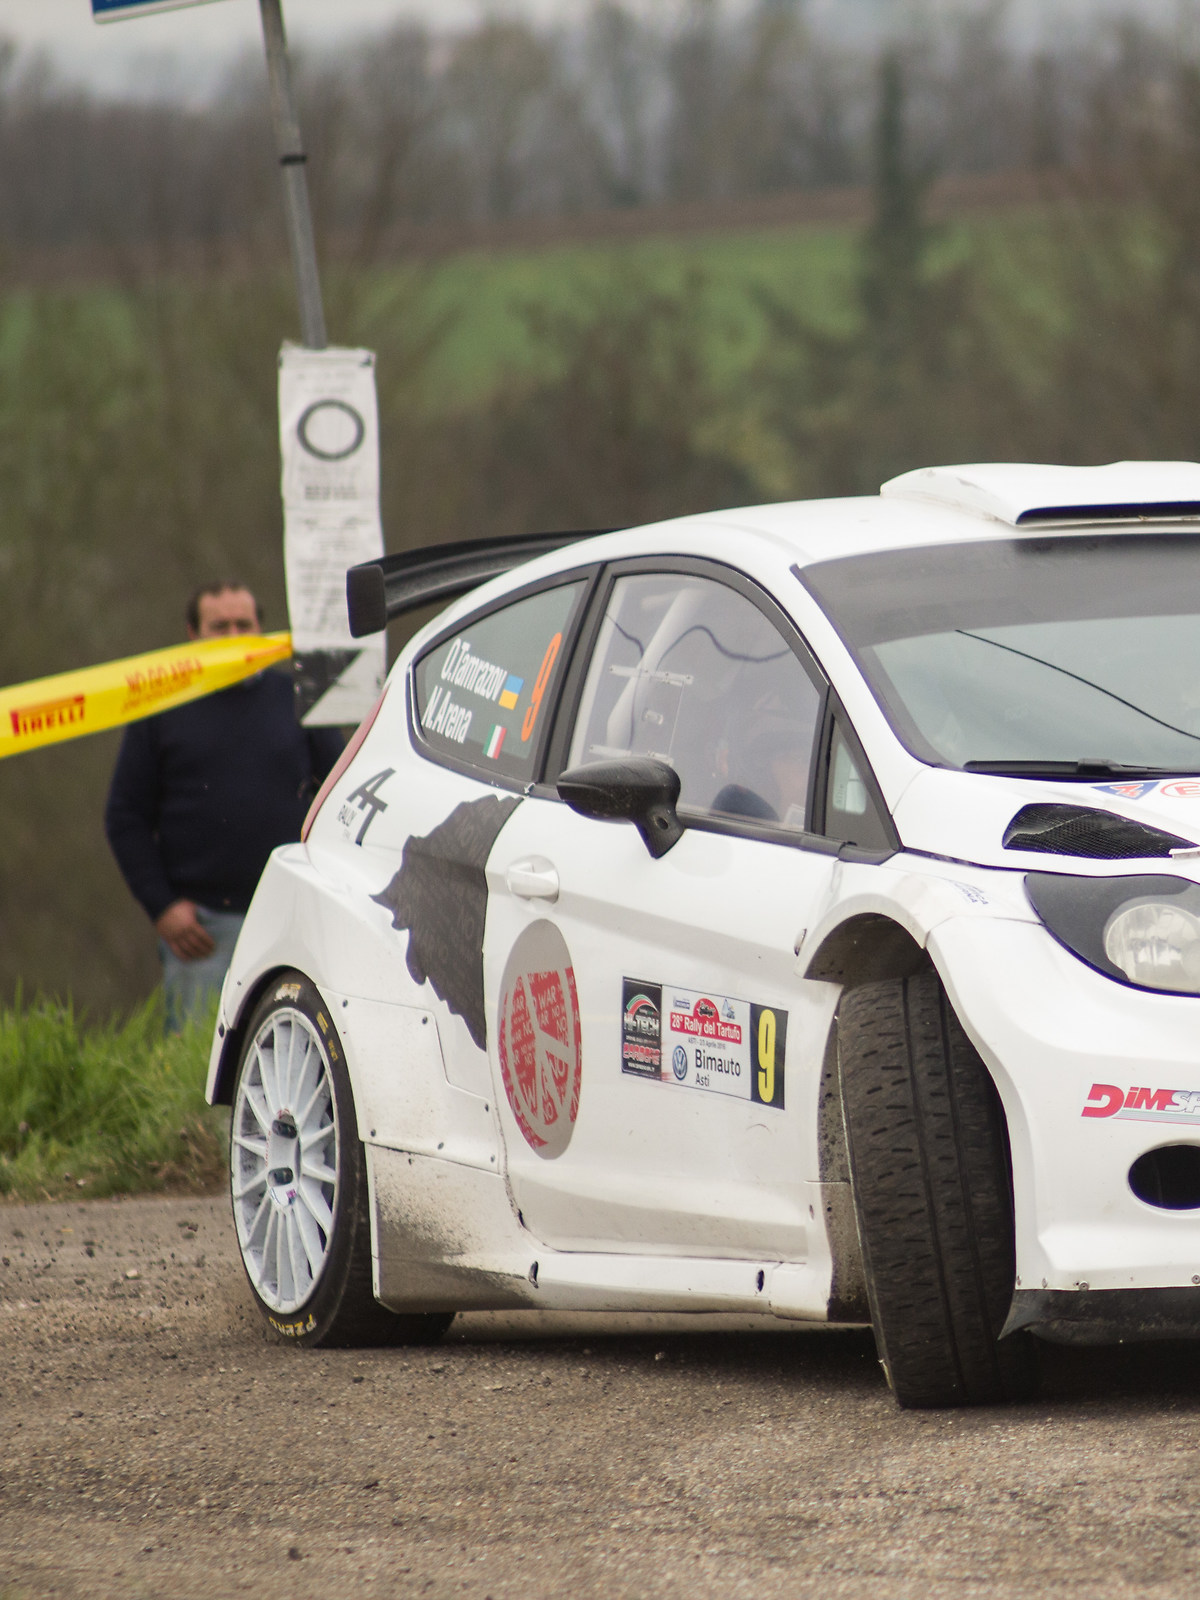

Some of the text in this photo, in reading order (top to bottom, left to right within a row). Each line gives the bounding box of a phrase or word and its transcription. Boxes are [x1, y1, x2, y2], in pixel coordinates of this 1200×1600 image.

[441, 637, 508, 702] O.Tamrazov
[520, 631, 563, 743] 9
[10, 694, 86, 737] PIRELLI
[421, 684, 473, 744] N.Arena
[684, 1016, 703, 1036] Rally
[703, 1020, 716, 1036] del
[716, 1021, 741, 1041] Tartufo
[694, 1049, 742, 1077] Bimauto
[695, 1073, 710, 1087] Asti
[757, 1008, 777, 1104] 9
